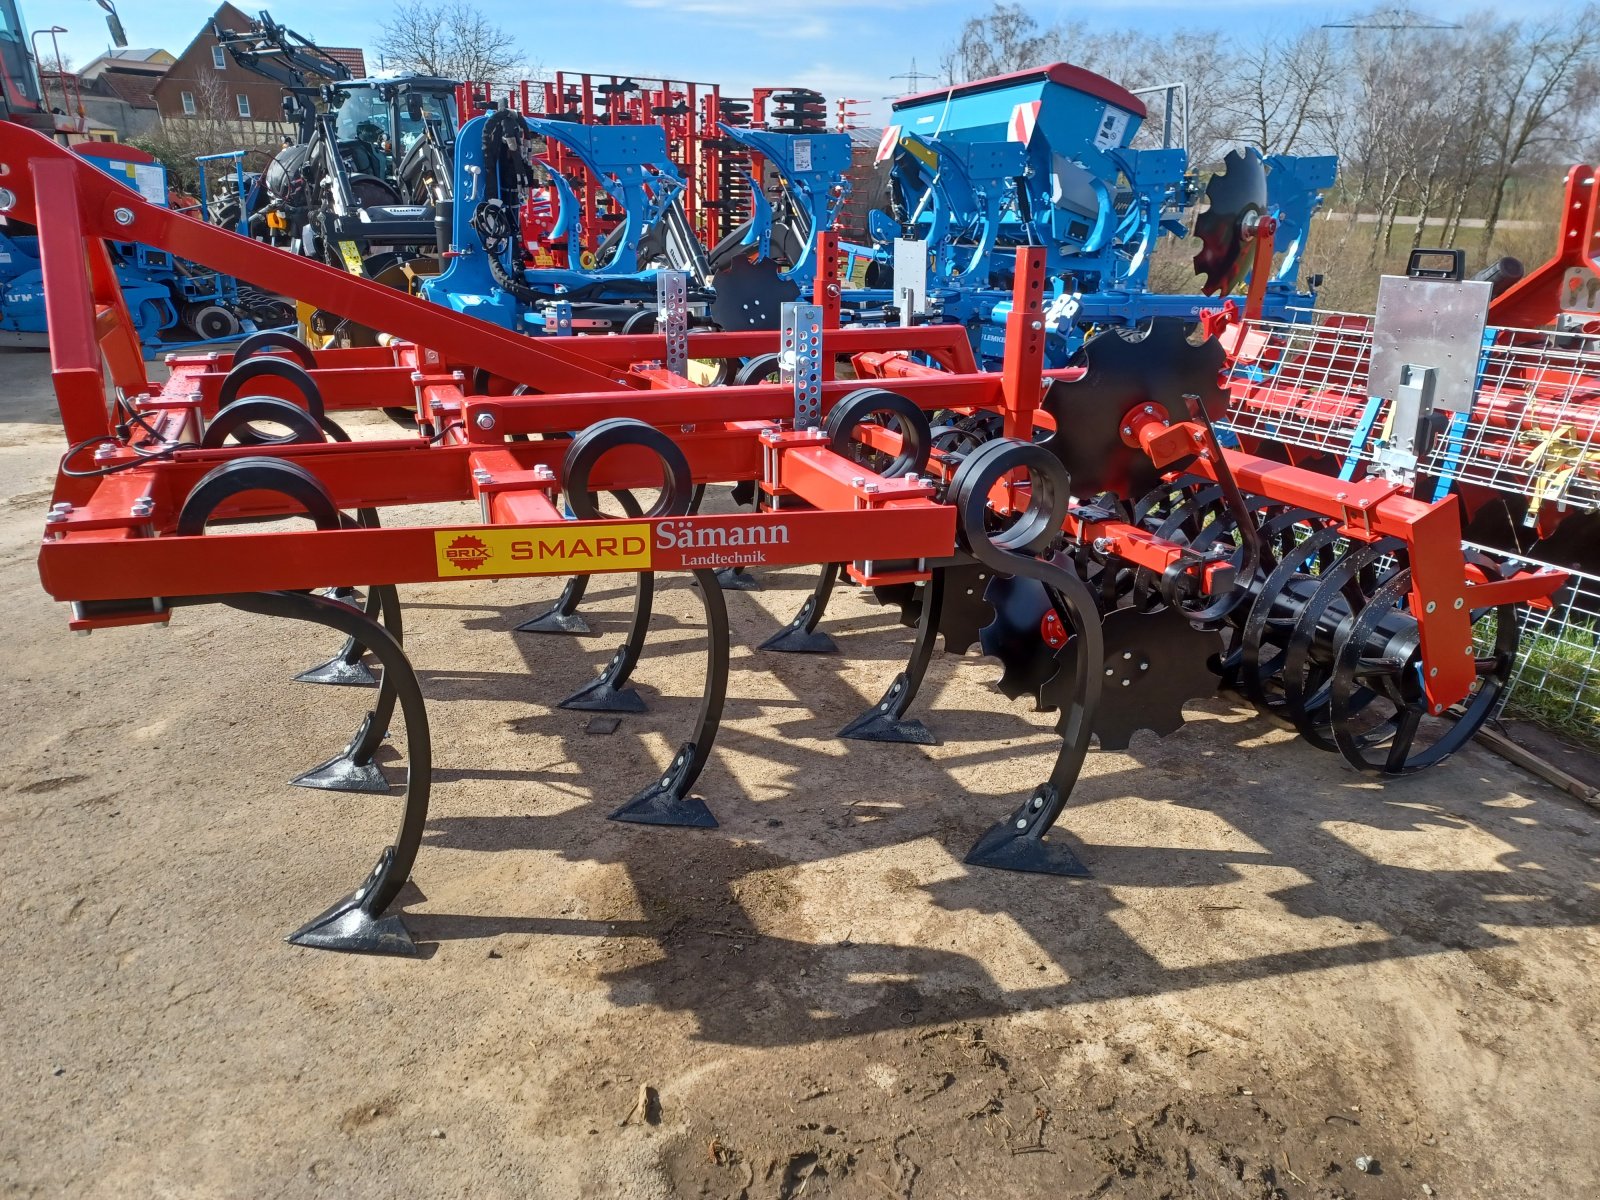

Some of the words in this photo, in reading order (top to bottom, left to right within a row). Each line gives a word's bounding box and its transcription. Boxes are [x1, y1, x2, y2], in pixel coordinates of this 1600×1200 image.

[656, 520, 790, 550] Sämann
[446, 547, 494, 558] BRIX
[511, 536, 646, 561] SMARD
[681, 551, 766, 567] Landtechnik
